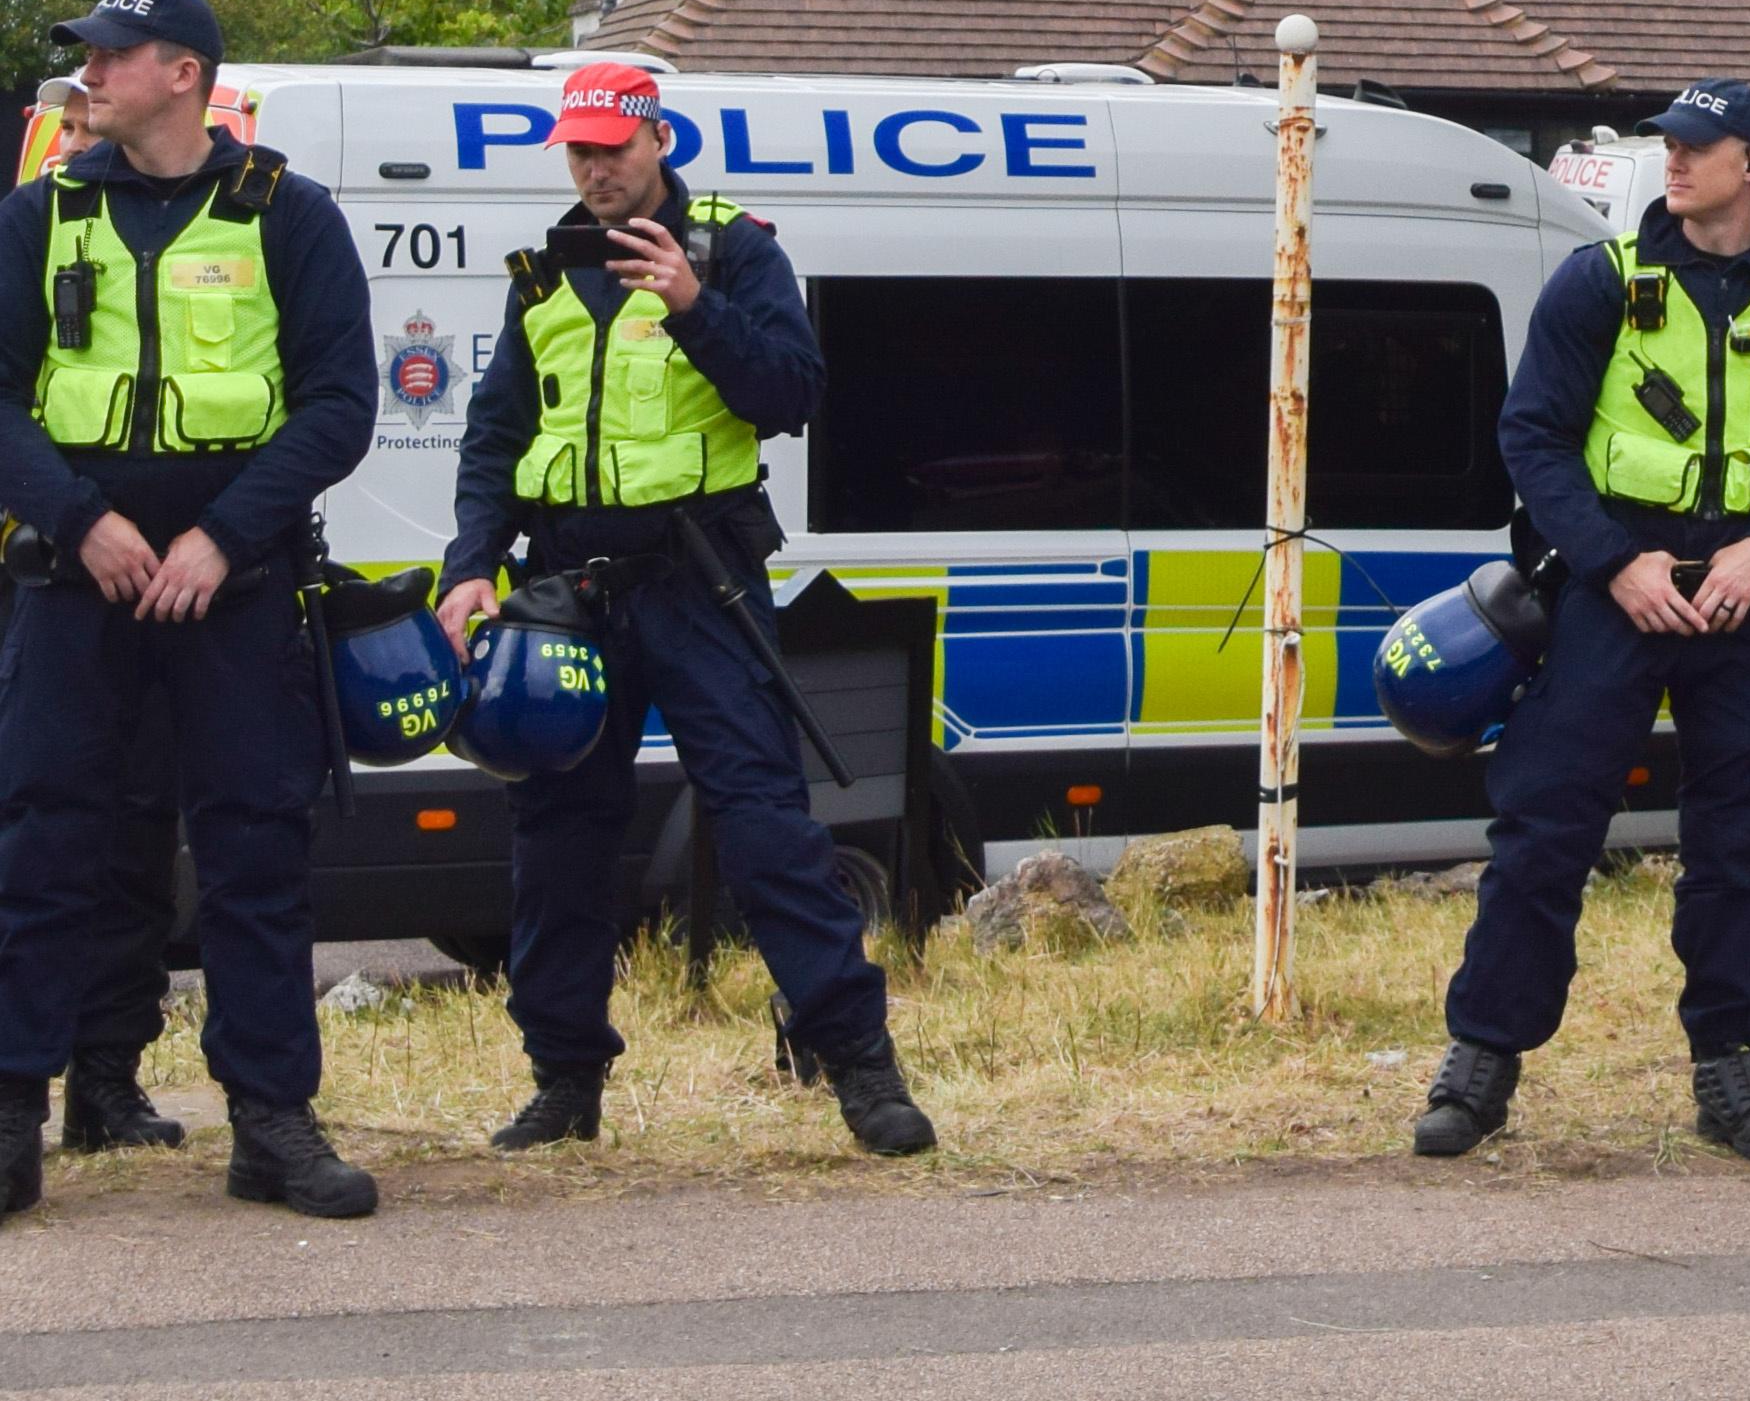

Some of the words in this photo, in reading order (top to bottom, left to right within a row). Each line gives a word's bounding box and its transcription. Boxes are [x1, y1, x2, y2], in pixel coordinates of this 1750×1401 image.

[1673, 88, 1729, 116] LICE
[374, 223, 466, 270] 701
[203, 265, 221, 274] VG
[541, 643, 589, 661] 3459
[1386, 638, 1412, 677] VG
[559, 665, 590, 692] VG
[380, 680, 450, 717] 76996
[402, 708, 437, 737] VG
